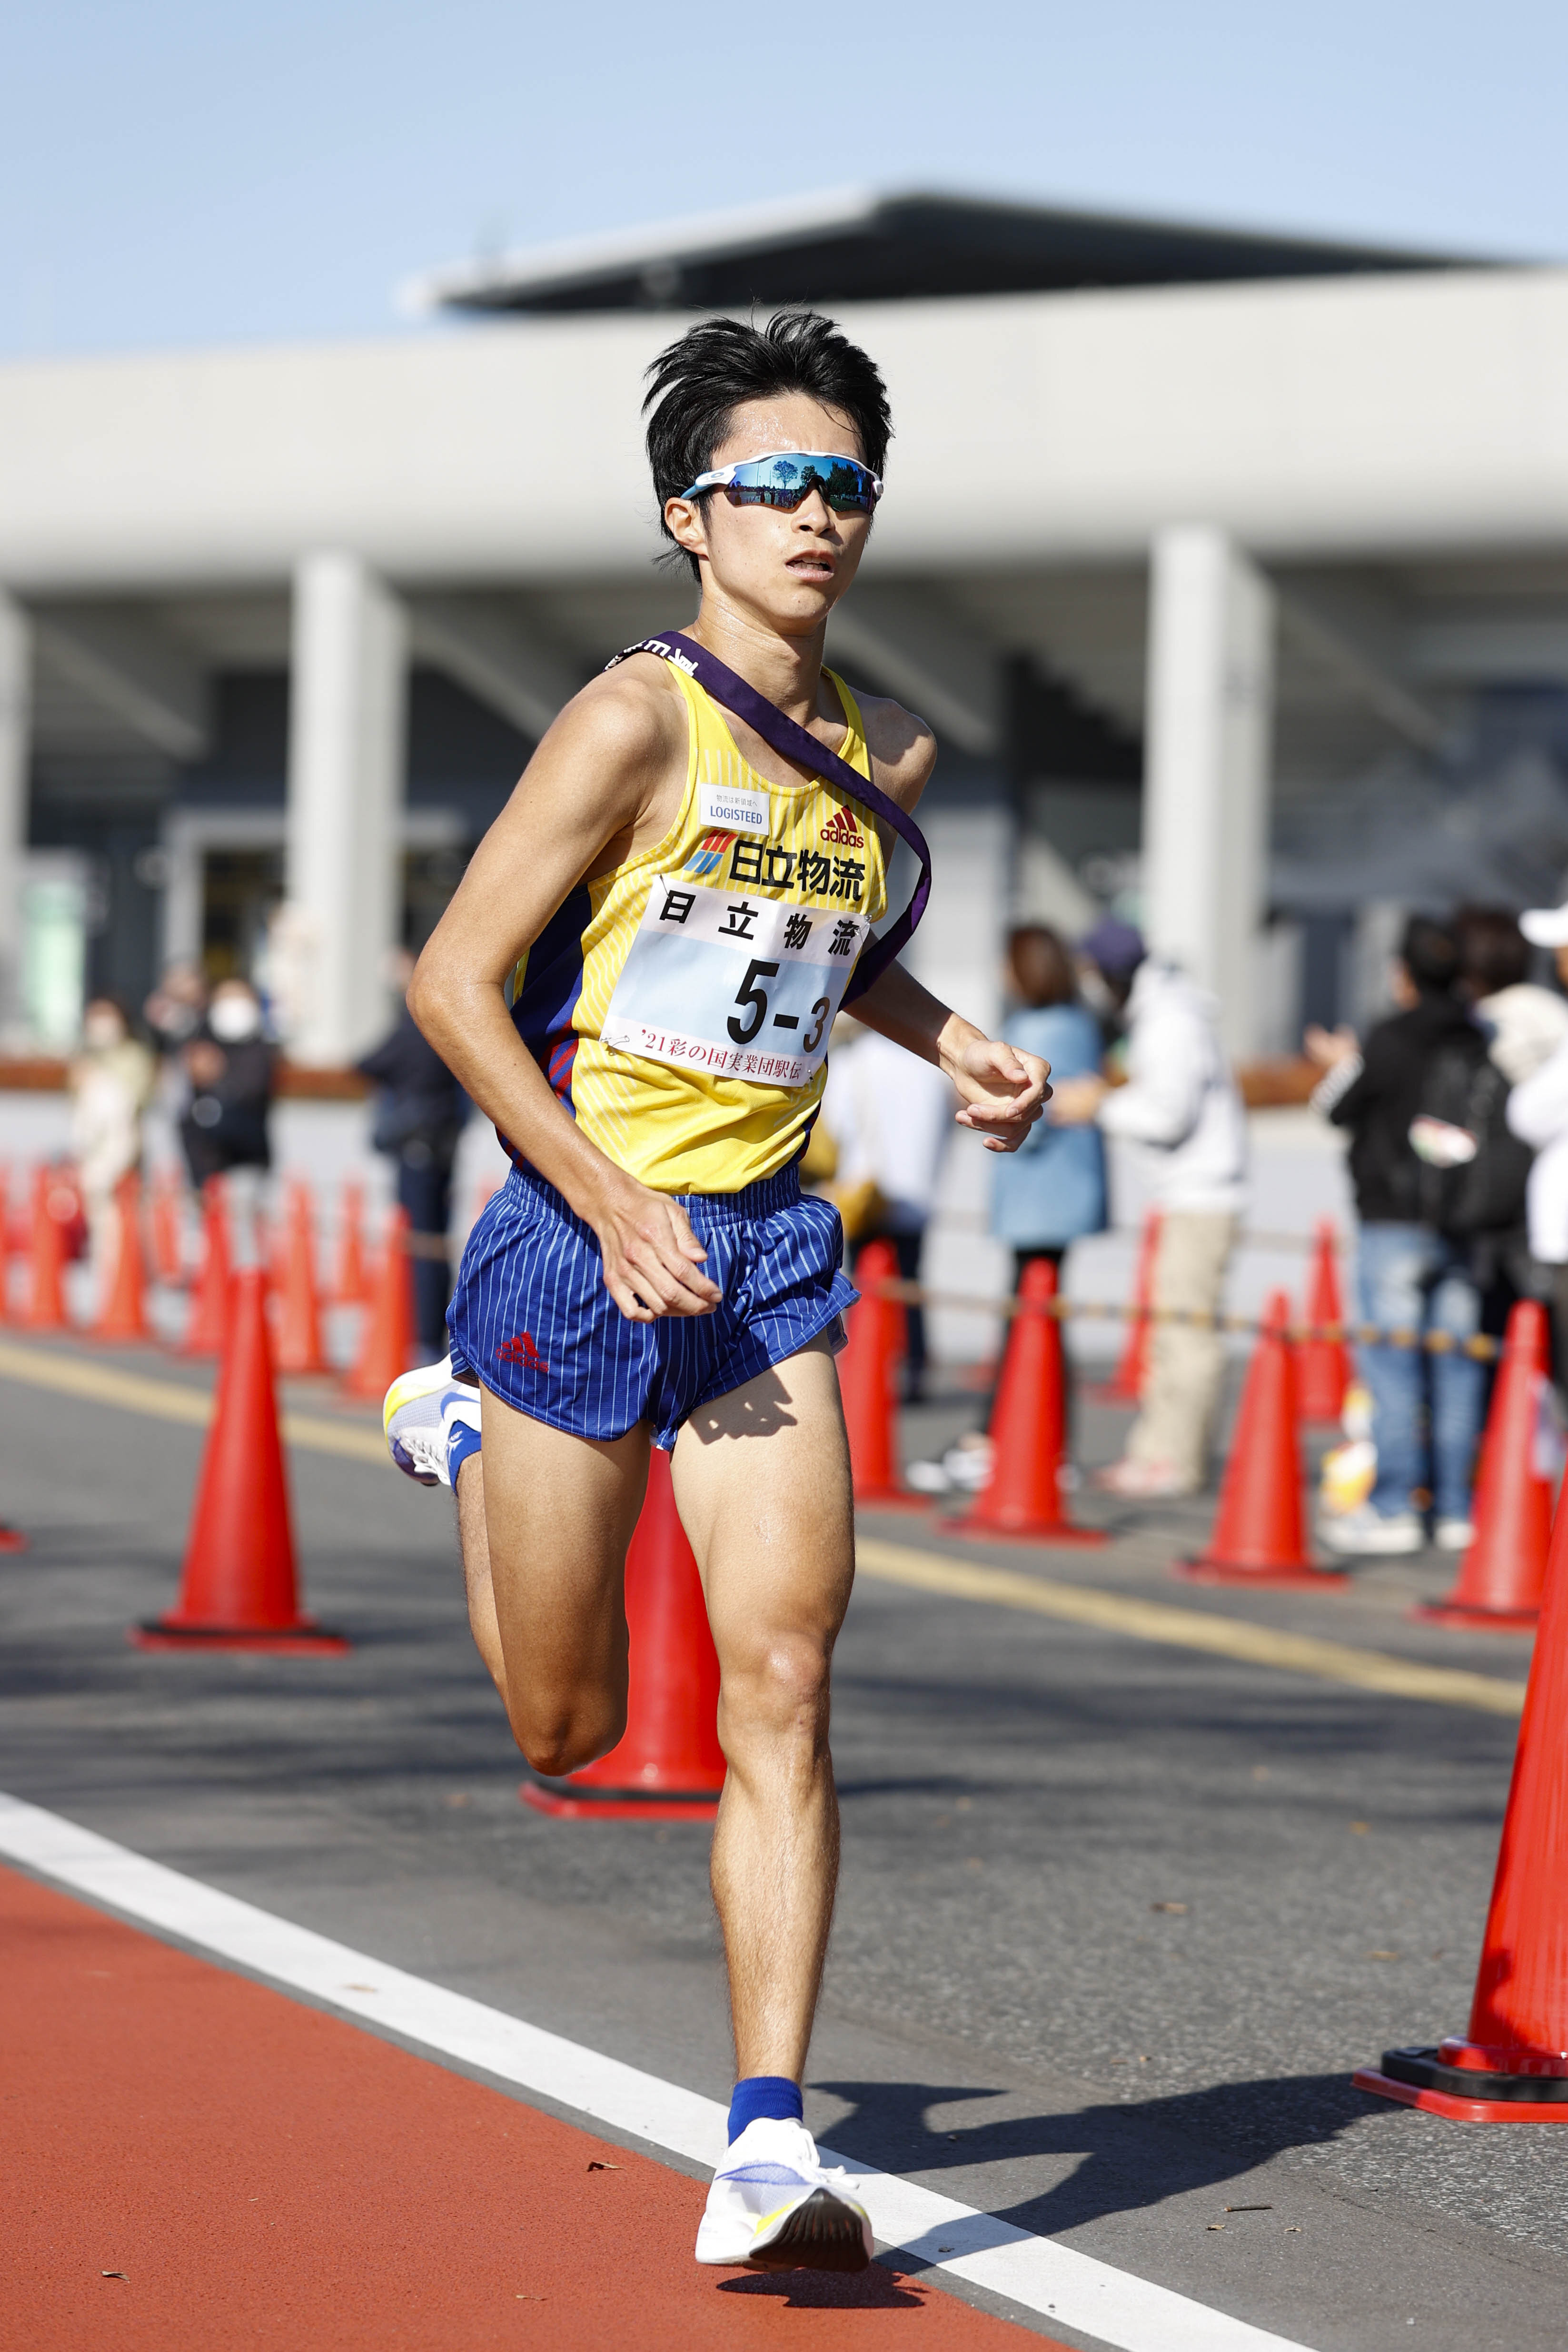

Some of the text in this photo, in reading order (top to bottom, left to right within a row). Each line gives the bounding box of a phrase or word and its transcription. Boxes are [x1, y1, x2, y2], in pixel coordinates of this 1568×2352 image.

[710, 805, 762, 824] LOGISTEED
[820, 828, 864, 848] adidas
[729, 840, 865, 902] 日立物流
[727, 959, 830, 1053] 5-3
[496, 1348, 549, 1373] adidas
